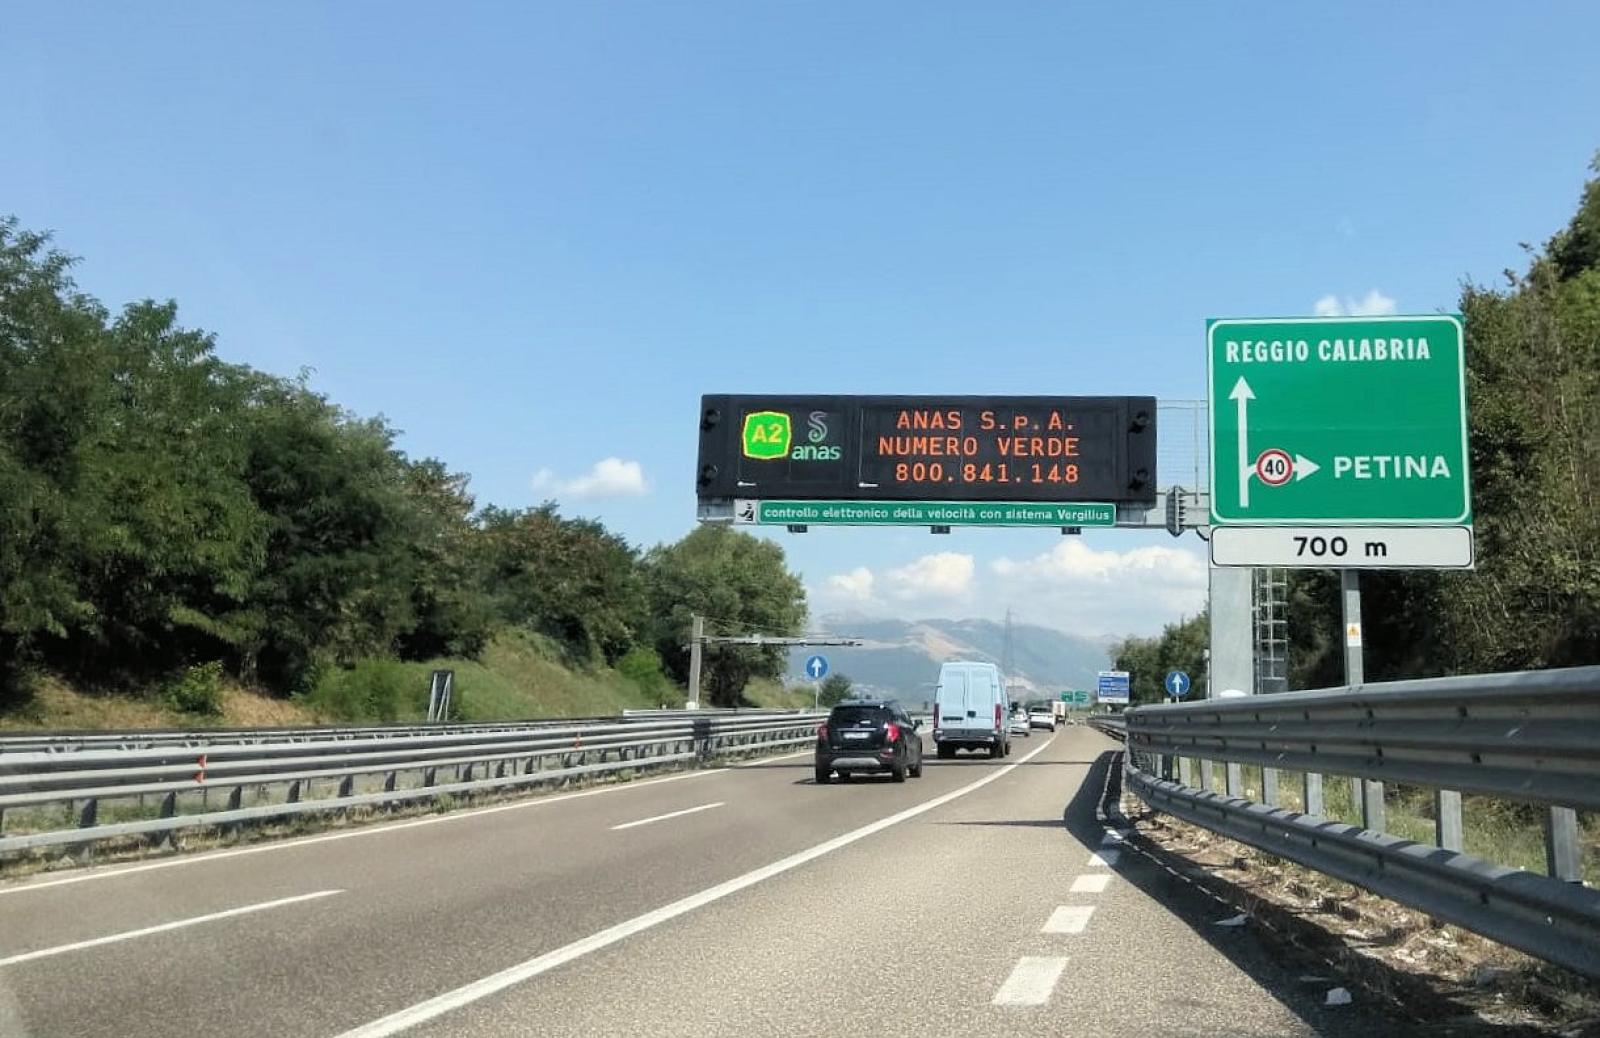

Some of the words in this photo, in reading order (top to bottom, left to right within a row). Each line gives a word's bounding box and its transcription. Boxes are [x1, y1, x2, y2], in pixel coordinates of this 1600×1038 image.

[1225, 340, 1308, 363] REGGIO
[1318, 338, 1431, 362] CALABRIA
[896, 411, 962, 430] ANAS
[980, 411, 1074, 430] S.p.A.
[751, 423, 783, 443] A2
[791, 445, 842, 460] anas
[879, 437, 978, 456] NUMERO
[997, 437, 1080, 456] VERDE
[895, 463, 1079, 483] 800.841.148
[1263, 459, 1285, 476] 40
[1333, 455, 1451, 479] PETINA
[764, 507, 818, 518] controllo
[822, 507, 889, 519] elettronico
[893, 507, 923, 519] della
[927, 508, 975, 519] velocità
[980, 511, 1001, 519] con
[1006, 508, 1052, 520] sistema
[1057, 508, 1110, 522] Vergilius
[1293, 536, 1348, 557] 700
[1365, 541, 1387, 557] m
